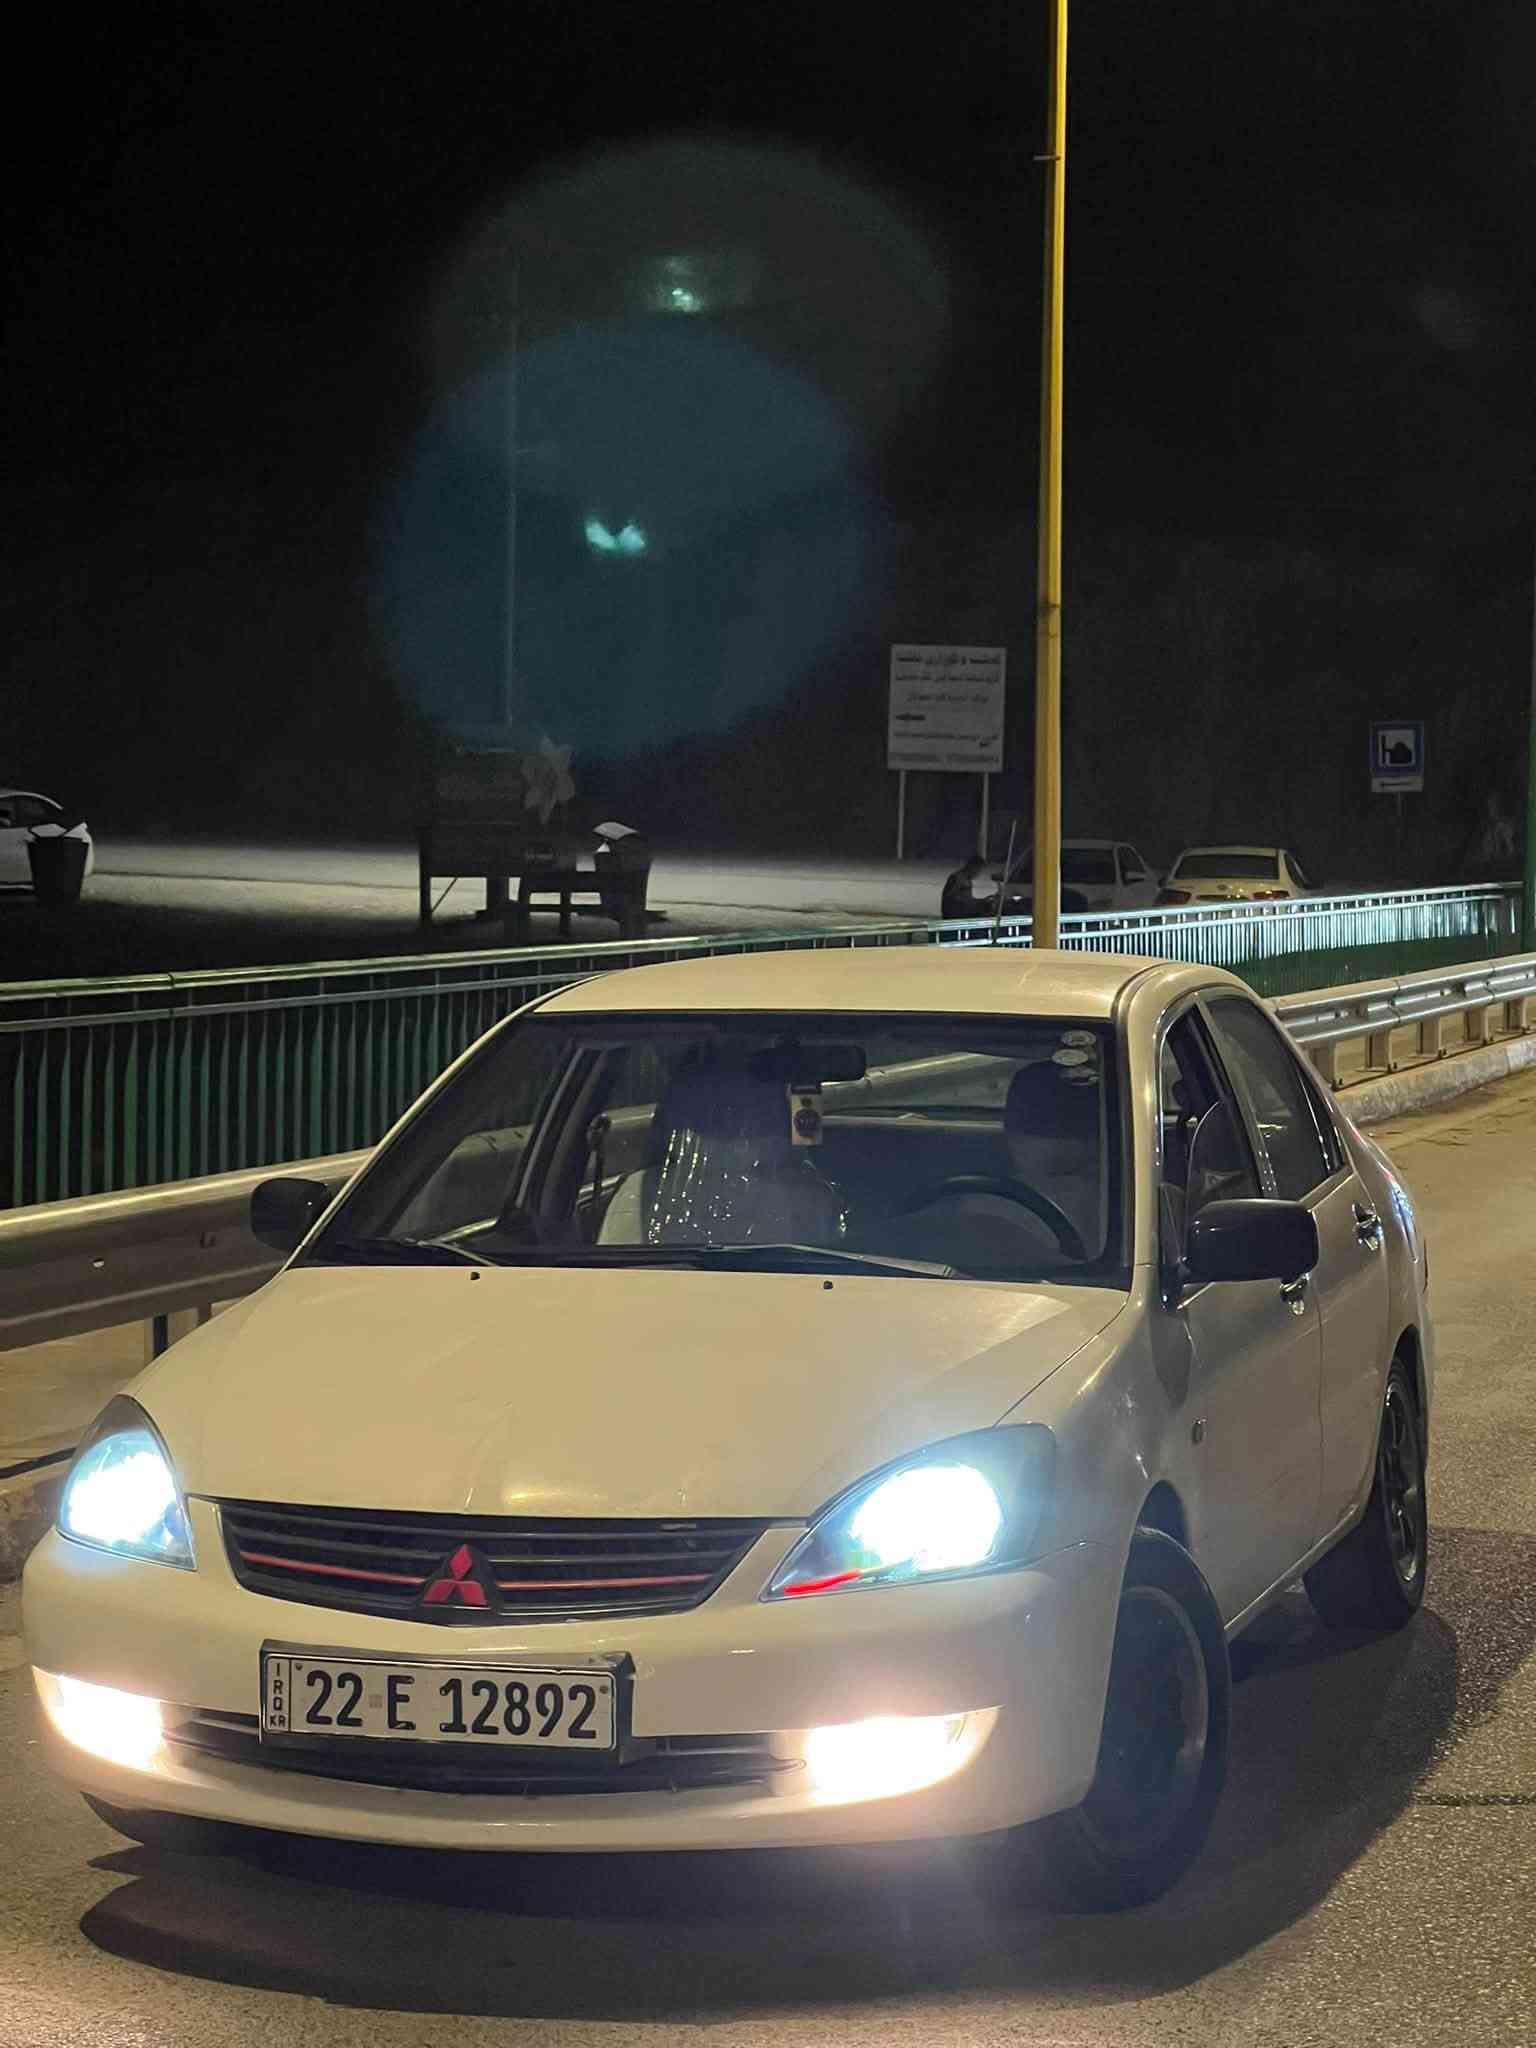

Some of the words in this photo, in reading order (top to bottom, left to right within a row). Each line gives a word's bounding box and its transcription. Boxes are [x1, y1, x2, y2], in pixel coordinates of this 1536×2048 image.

[269, 1714, 287, 1728] KR
[306, 1670, 363, 1726] 22
[387, 1674, 416, 1731] E
[439, 1678, 597, 1739] 12892
